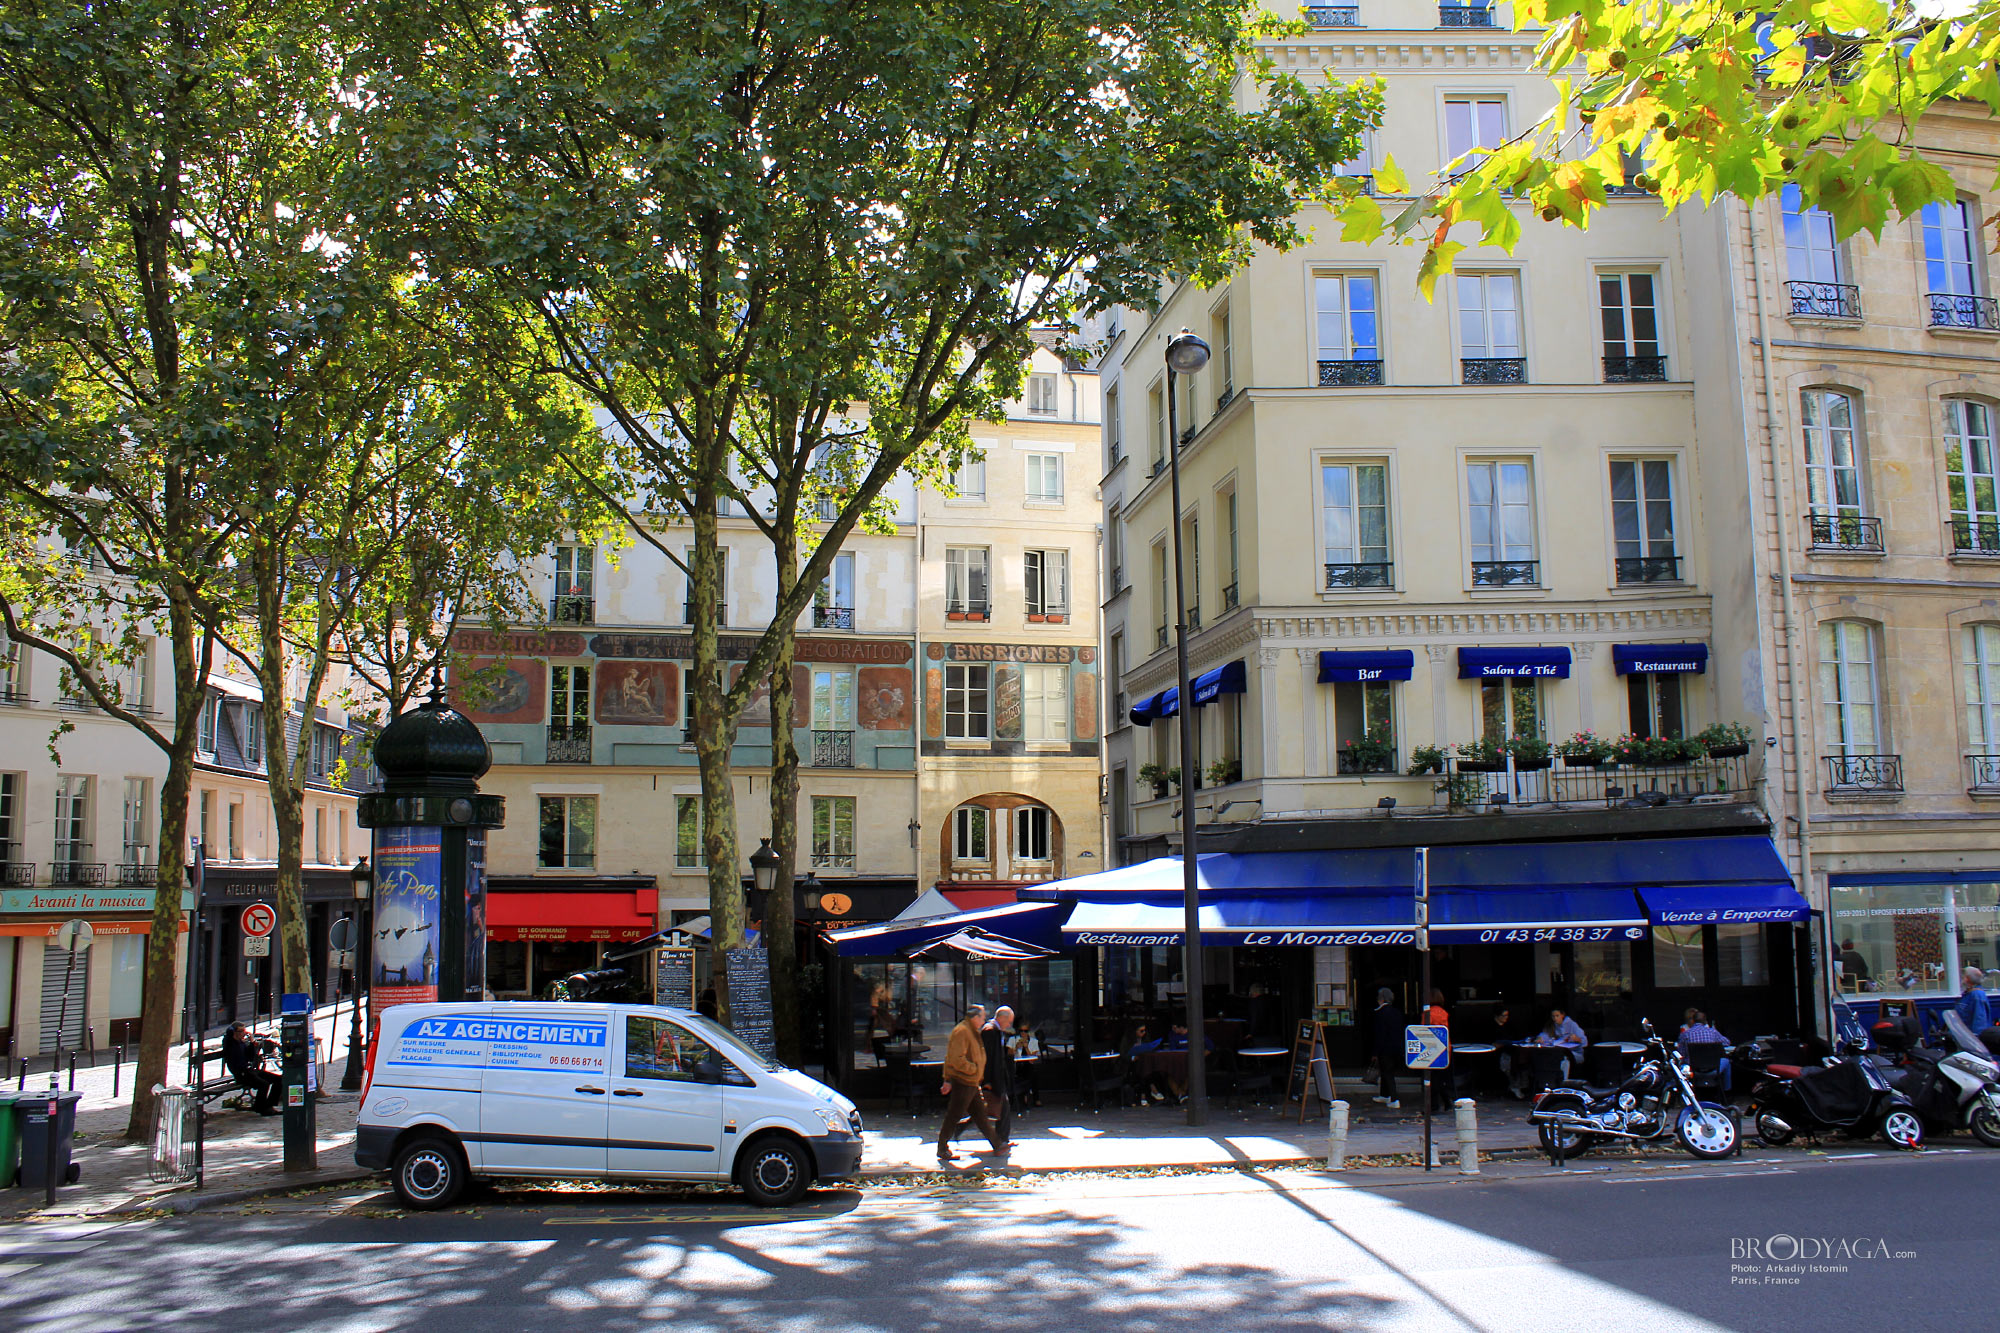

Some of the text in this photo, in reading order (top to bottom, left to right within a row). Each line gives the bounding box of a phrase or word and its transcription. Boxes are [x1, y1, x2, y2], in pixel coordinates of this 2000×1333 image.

[954, 644, 1070, 662] ENSEIGNES
[1082, 650, 1090, 660] 3
[1482, 664, 1556, 675] Salon de Thé
[1634, 661, 1697, 671] Restaurant
[1358, 668, 1382, 681] Bar
[226, 884, 256, 896] ATELIER
[400, 870, 439, 900] Pan
[28, 893, 146, 908] Avanti la musica
[1661, 908, 1797, 922] Vente à Emporter
[1906, 907, 1928, 915] JEUNES
[96, 924, 130, 934] musica
[1480, 928, 1612, 942] 01 43 54 38 37
[1076, 932, 1179, 945] Restaurant
[1243, 932, 1415, 945] Le Montebello
[306, 998, 311, 1013] P
[418, 1021, 602, 1044] AZ AGENCEMENT
[402, 1047, 443, 1055] MENUISERIE
[560, 1056, 570, 1065] 60
[582, 1057, 591, 1066] 87
[593, 1058, 602, 1067] 14
